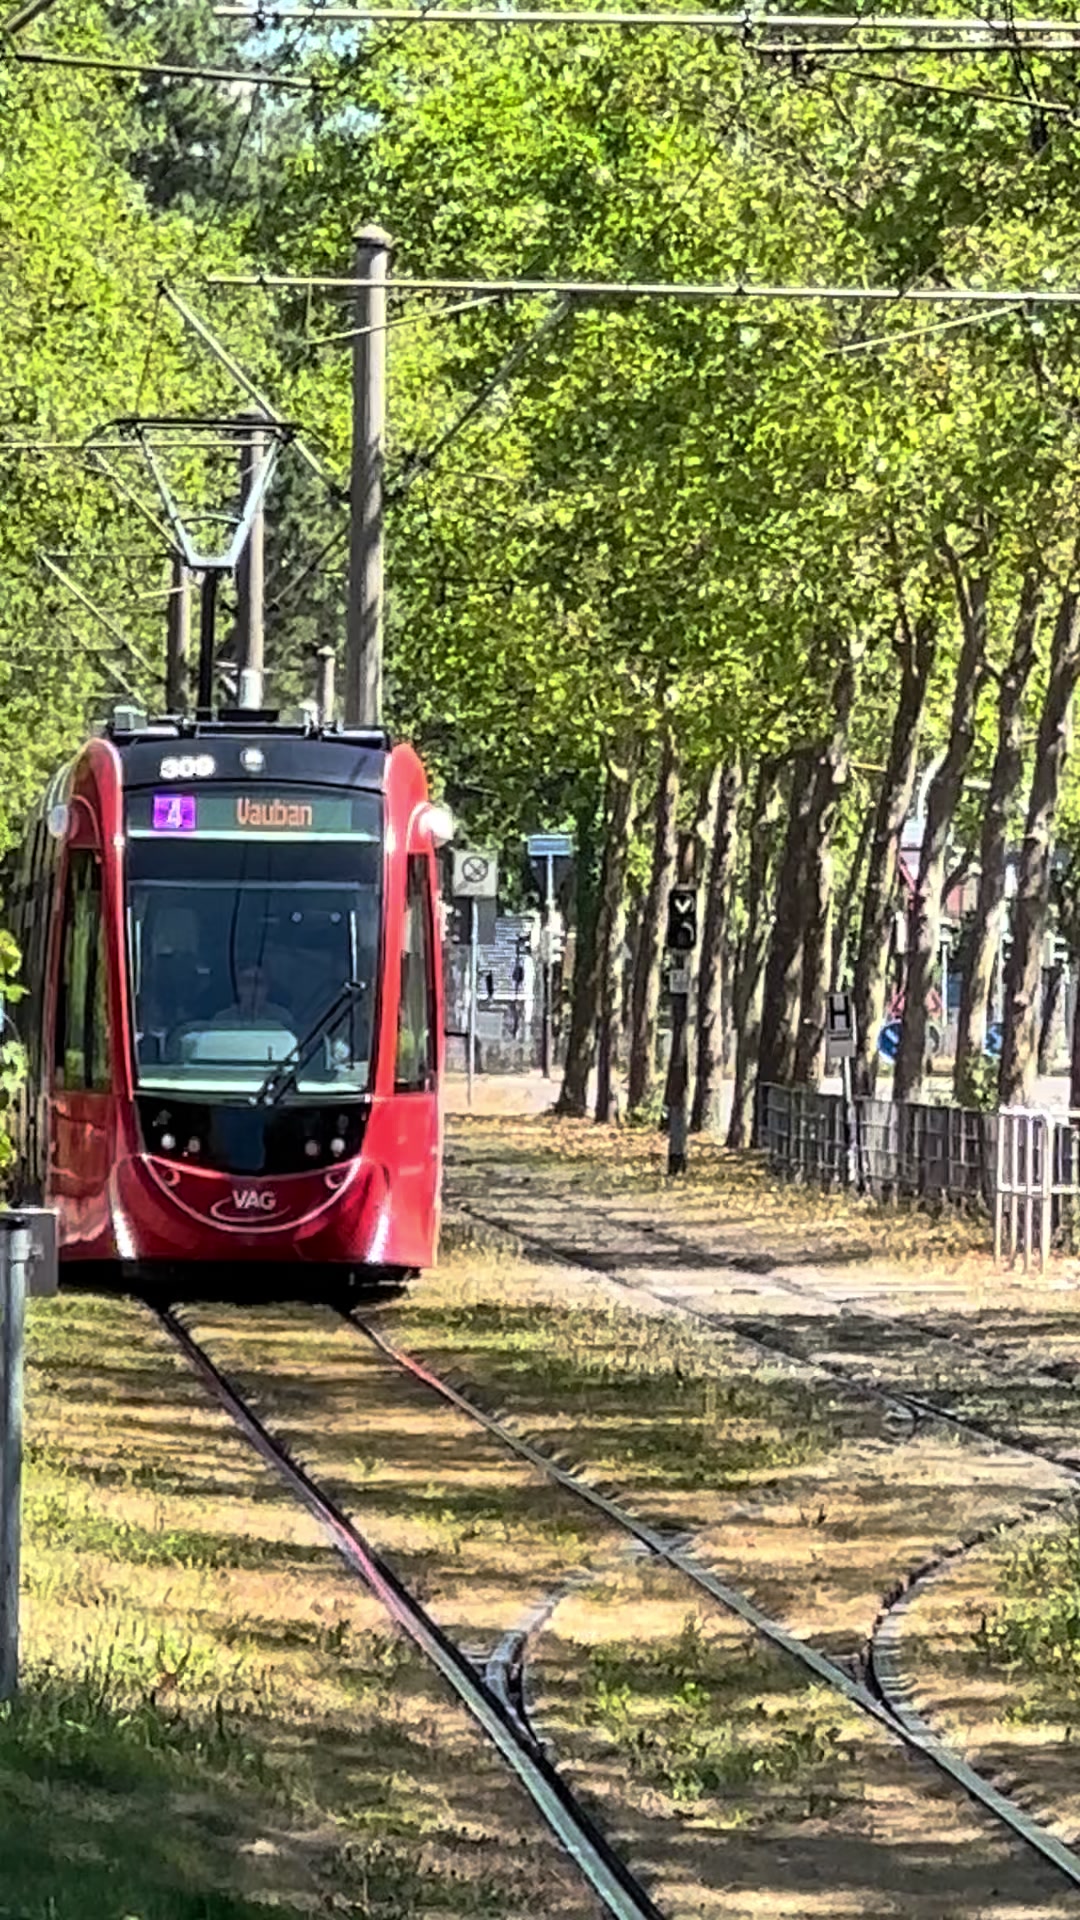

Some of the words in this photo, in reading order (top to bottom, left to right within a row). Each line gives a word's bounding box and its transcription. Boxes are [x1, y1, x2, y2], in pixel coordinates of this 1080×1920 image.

[237, 797, 312, 825] Vauban
[830, 996, 850, 1029] H
[233, 1190, 276, 1210] VAG
